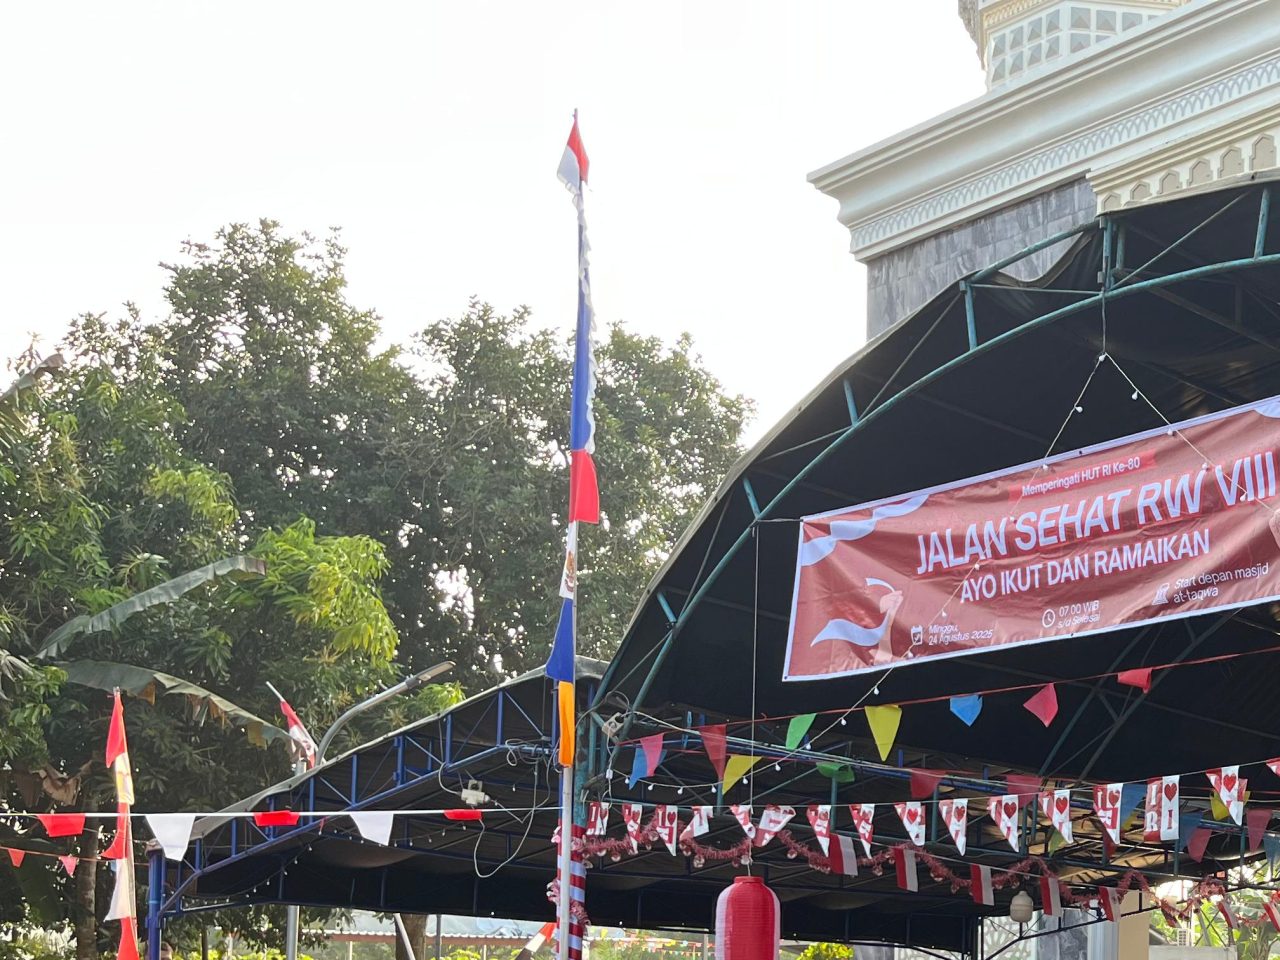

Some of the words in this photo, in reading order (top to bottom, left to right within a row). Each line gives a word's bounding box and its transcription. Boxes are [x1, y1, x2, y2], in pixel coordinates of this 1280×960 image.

[1022, 471, 1080, 497] Memperingati
[1081, 467, 1101, 482] HUT
[1102, 465, 1111, 477] RI
[1113, 456, 1141, 473] Ke-80
[917, 516, 1008, 575] JALAN
[1014, 489, 1132, 551] SEHAT
[1137, 469, 1206, 525] RW
[1215, 451, 1276, 507] VIII
[960, 574, 997, 604] AYO
[1001, 564, 1043, 596] IKUT
[1047, 557, 1089, 586] DAN
[1094, 528, 1211, 576] RAMAIKAN
[1198, 568, 1233, 586] depan
[1234, 562, 1269, 580] masjid
[1173, 586, 1219, 604] at-taqwa
[928, 635, 938, 646] 24
[939, 631, 969, 646] Agustus
[971, 629, 993, 640] 2025
